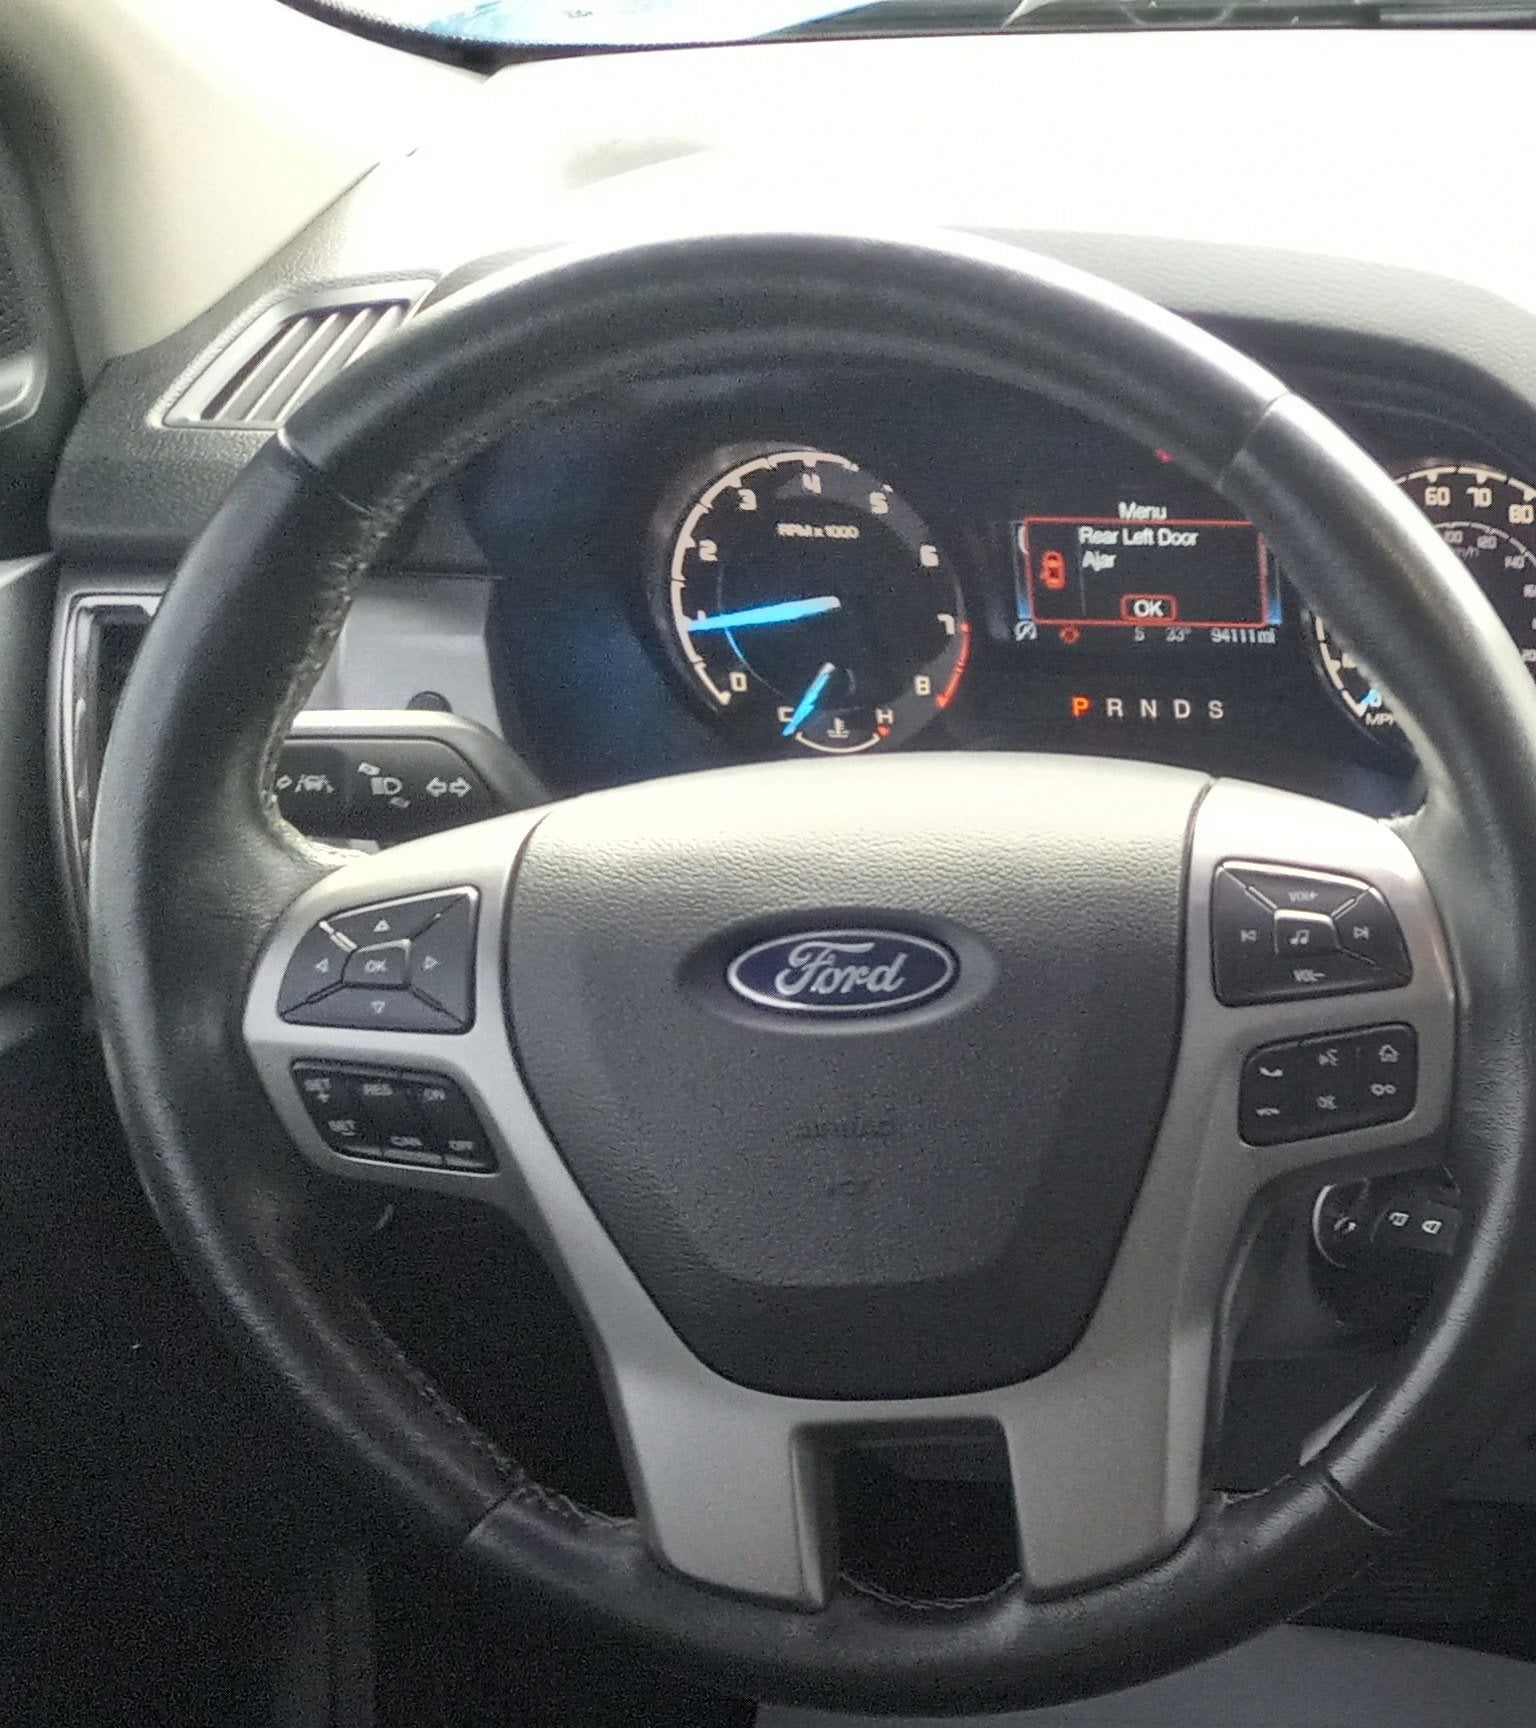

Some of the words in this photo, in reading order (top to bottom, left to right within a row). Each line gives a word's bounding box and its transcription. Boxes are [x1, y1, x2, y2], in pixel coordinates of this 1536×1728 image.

[802, 472, 822, 494] 4
[737, 488, 757, 511] 3
[869, 491, 889, 515] 5
[1424, 486, 1450, 507] 60
[1466, 486, 1493, 508] 70
[1118, 501, 1167, 521] Menu
[1508, 504, 1534, 525] 80
[824, 525, 860, 539] 1000
[1078, 526, 1119, 545] Rear
[1122, 528, 1155, 545] Left
[1157, 528, 1199, 547] Door
[698, 539, 718, 562] 2
[918, 544, 939, 567] 6
[1081, 550, 1117, 572] Ajar
[1133, 599, 1164, 618] OK
[938, 613, 955, 635] 7
[729, 671, 747, 692] 0
[914, 674, 931, 696] 8
[875, 708, 894, 725] H
[1072, 696, 1090, 717] P
[1106, 698, 1124, 718] R
[1140, 699, 1158, 719] N
[1173, 699, 1192, 719] D
[1208, 700, 1225, 719] S
[364, 959, 387, 974] OK
[774, 940, 908, 996] Ford
